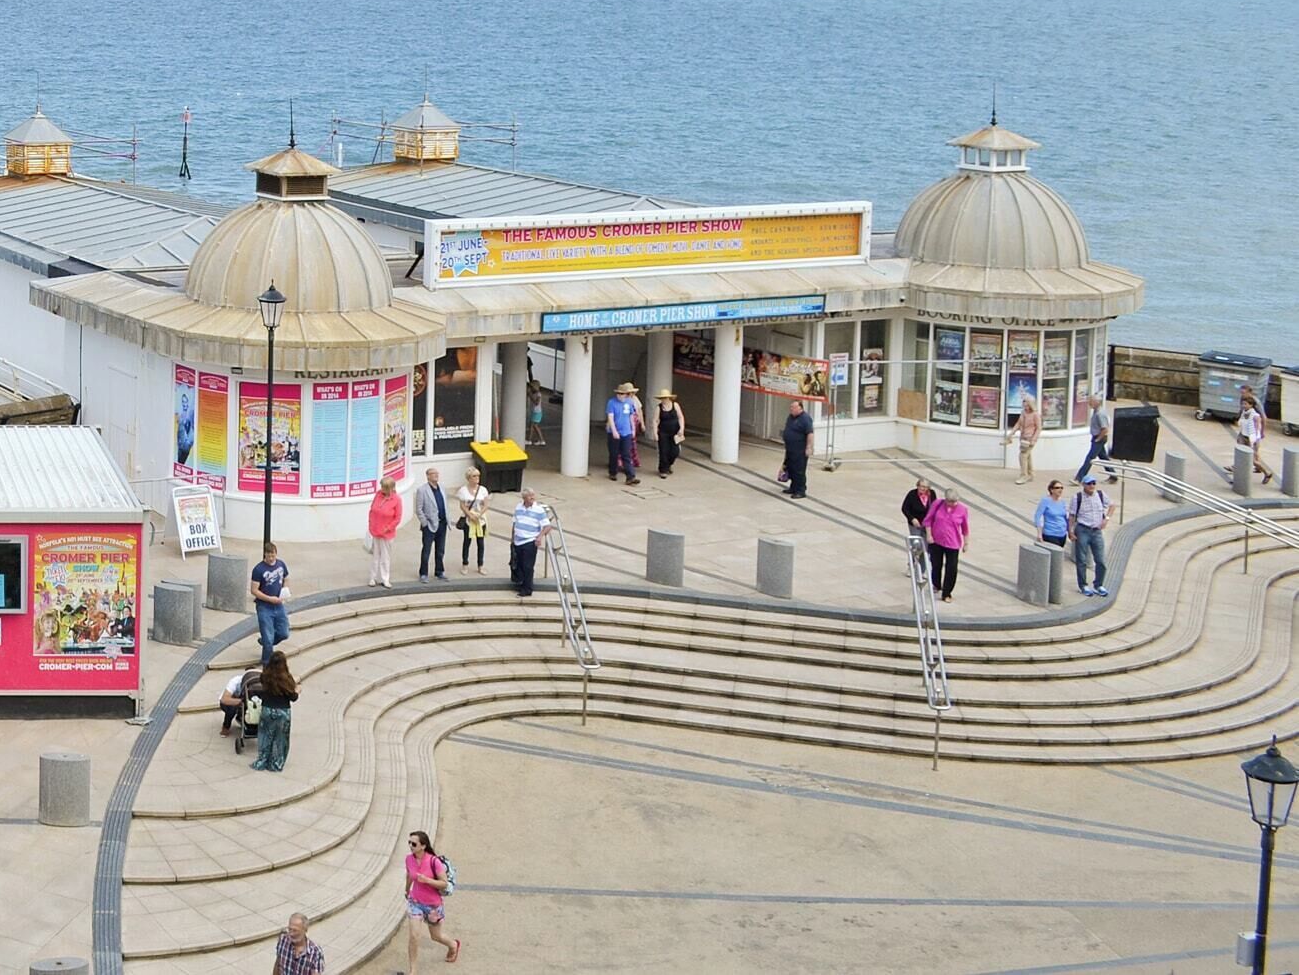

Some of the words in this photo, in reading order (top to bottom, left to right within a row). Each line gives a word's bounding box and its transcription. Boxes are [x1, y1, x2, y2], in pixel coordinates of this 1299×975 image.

[503, 229, 531, 243] THE
[536, 226, 597, 241] FAMOUS
[603, 222, 661, 237] CROMER
[666, 220, 697, 234] PIER
[701, 218, 743, 232] SHOW
[464, 252, 487, 266] SEPT
[569, 313, 600, 327] HOME
[612, 309, 658, 325] CROMER
[660, 307, 686, 322] PIER
[687, 304, 718, 320] SHOW
[917, 309, 993, 324] BOOKING
[294, 367, 395, 380] RESTAURANT
[189, 523, 208, 535] BOX
[186, 535, 216, 549] OFFICE
[42, 553, 96, 563] CROMER
[101, 553, 130, 563] PIER
[73, 564, 100, 573] SHOW
